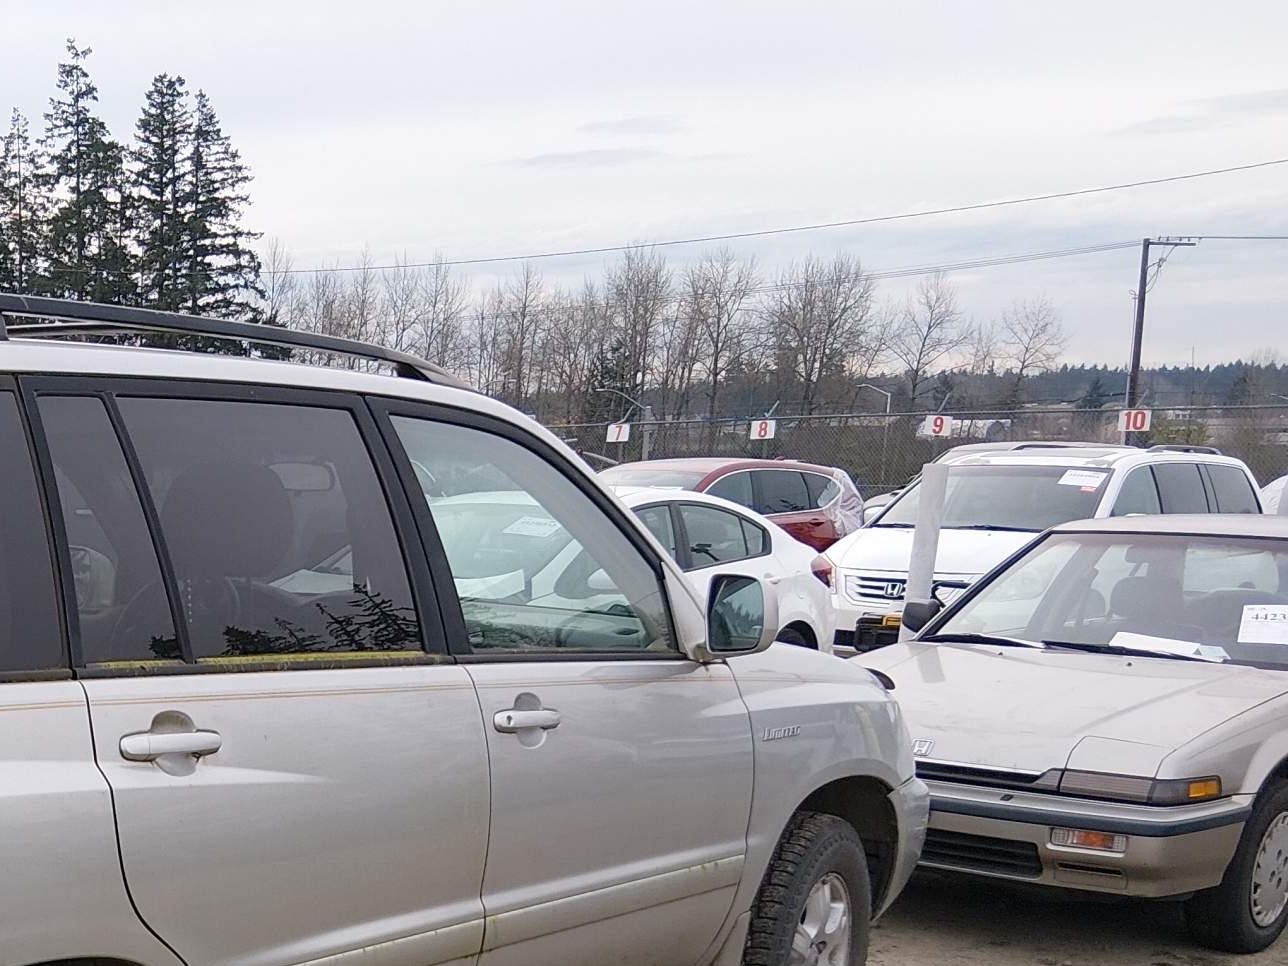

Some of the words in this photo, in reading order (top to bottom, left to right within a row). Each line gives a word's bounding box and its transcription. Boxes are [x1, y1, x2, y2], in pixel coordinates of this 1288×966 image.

[931, 416, 944, 434] 9
[1124, 411, 1146, 430] 10
[615, 425, 623, 441] 7
[758, 421, 769, 438] 8
